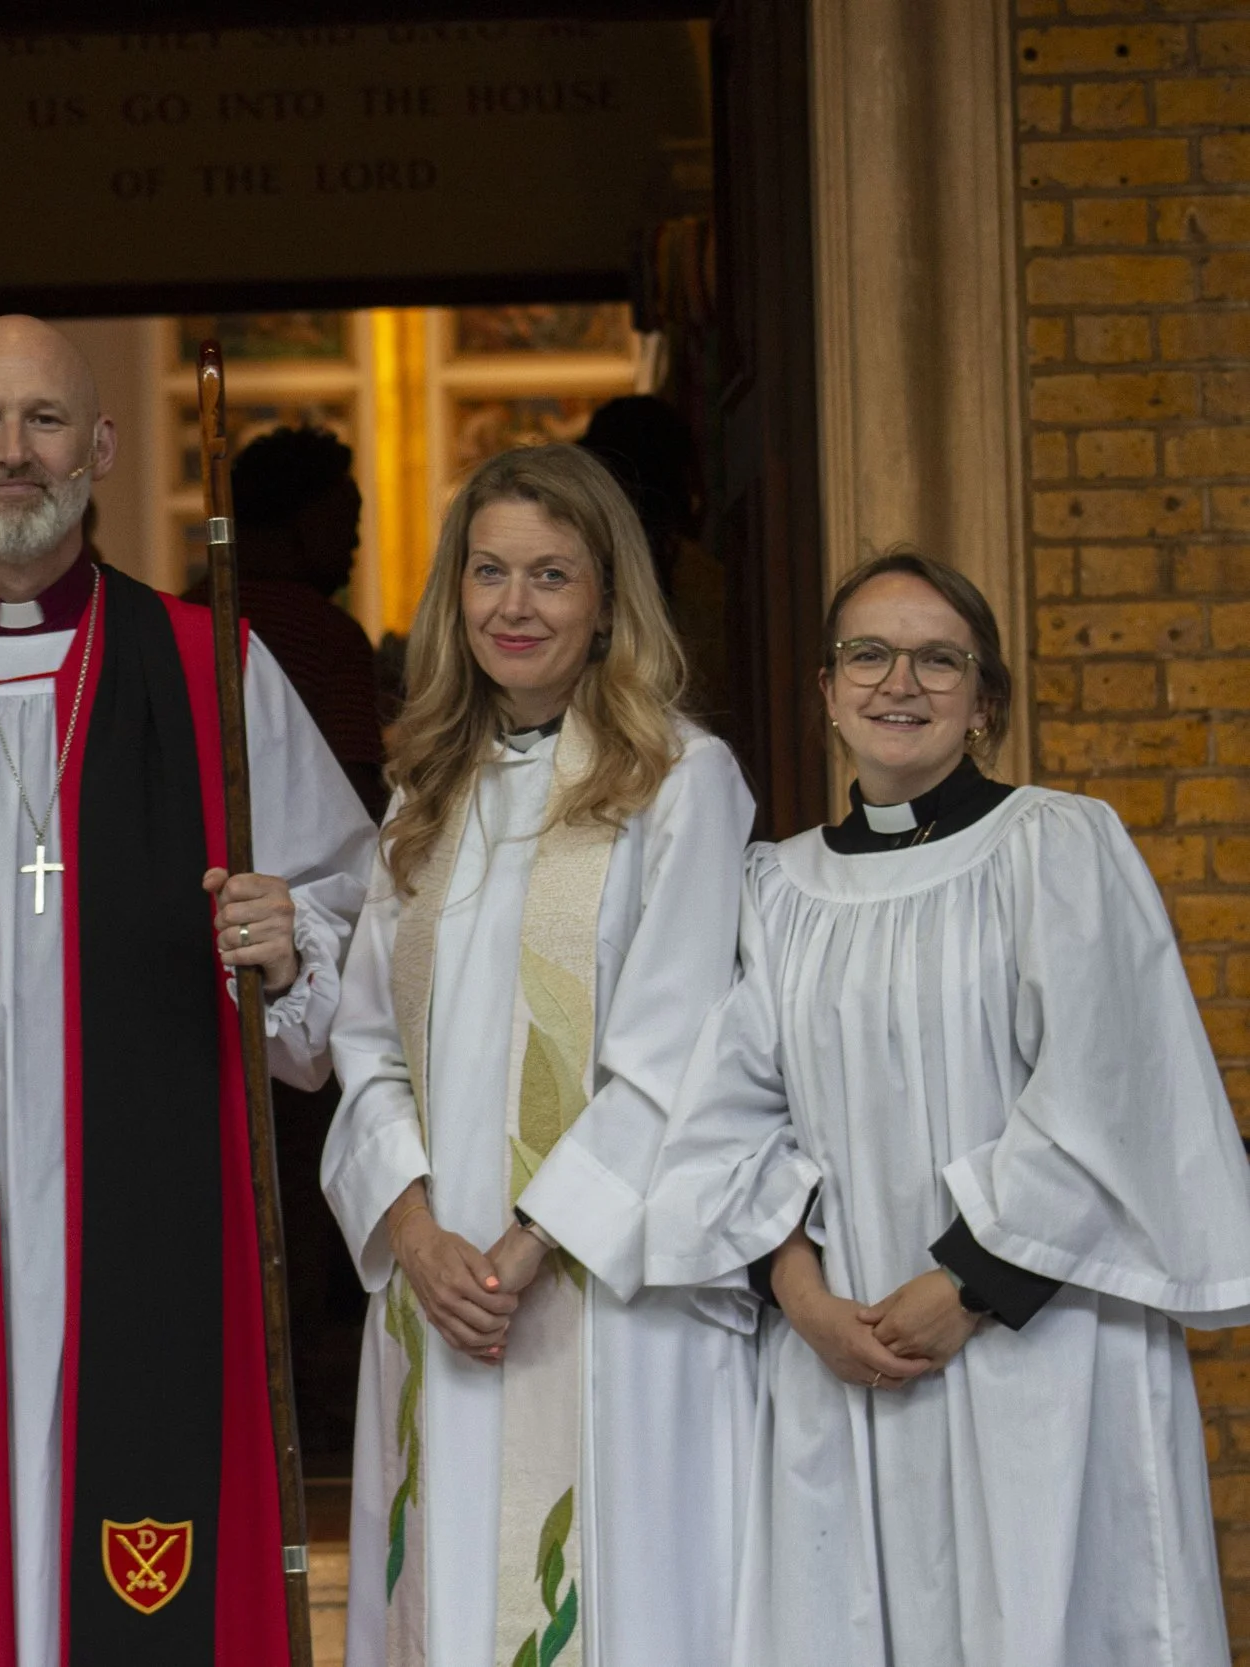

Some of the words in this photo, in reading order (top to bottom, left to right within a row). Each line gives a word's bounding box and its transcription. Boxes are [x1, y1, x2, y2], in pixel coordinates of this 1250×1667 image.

[29, 97, 88, 128] US
[122, 93, 189, 126] GO
[221, 91, 325, 123] INTO
[360, 86, 440, 117] THE
[464, 79, 620, 114] HOUSE
[113, 167, 166, 199] OF
[197, 164, 282, 196] THE
[315, 159, 438, 192] LORD
[137, 1529, 158, 1550] D
